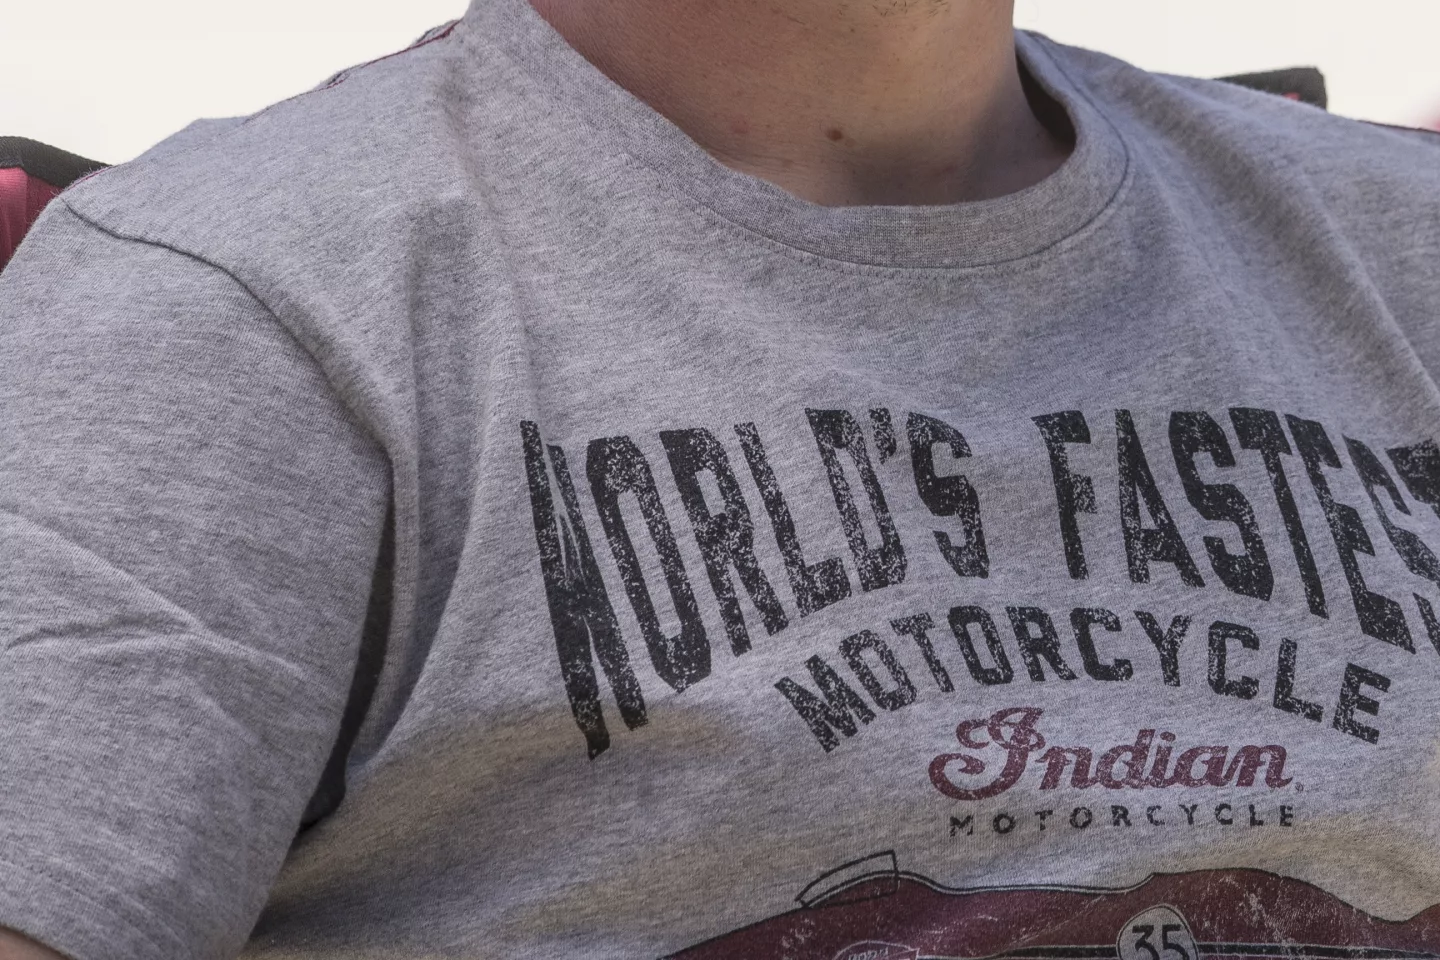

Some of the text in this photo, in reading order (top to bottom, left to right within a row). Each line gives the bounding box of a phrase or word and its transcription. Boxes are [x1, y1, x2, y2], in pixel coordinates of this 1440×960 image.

[773, 604, 1392, 753] MOTORCYCLE
[927, 706, 1294, 802] Indian
[949, 802, 1294, 838] MOTORCYCLE
[1131, 923, 1190, 960] 35
